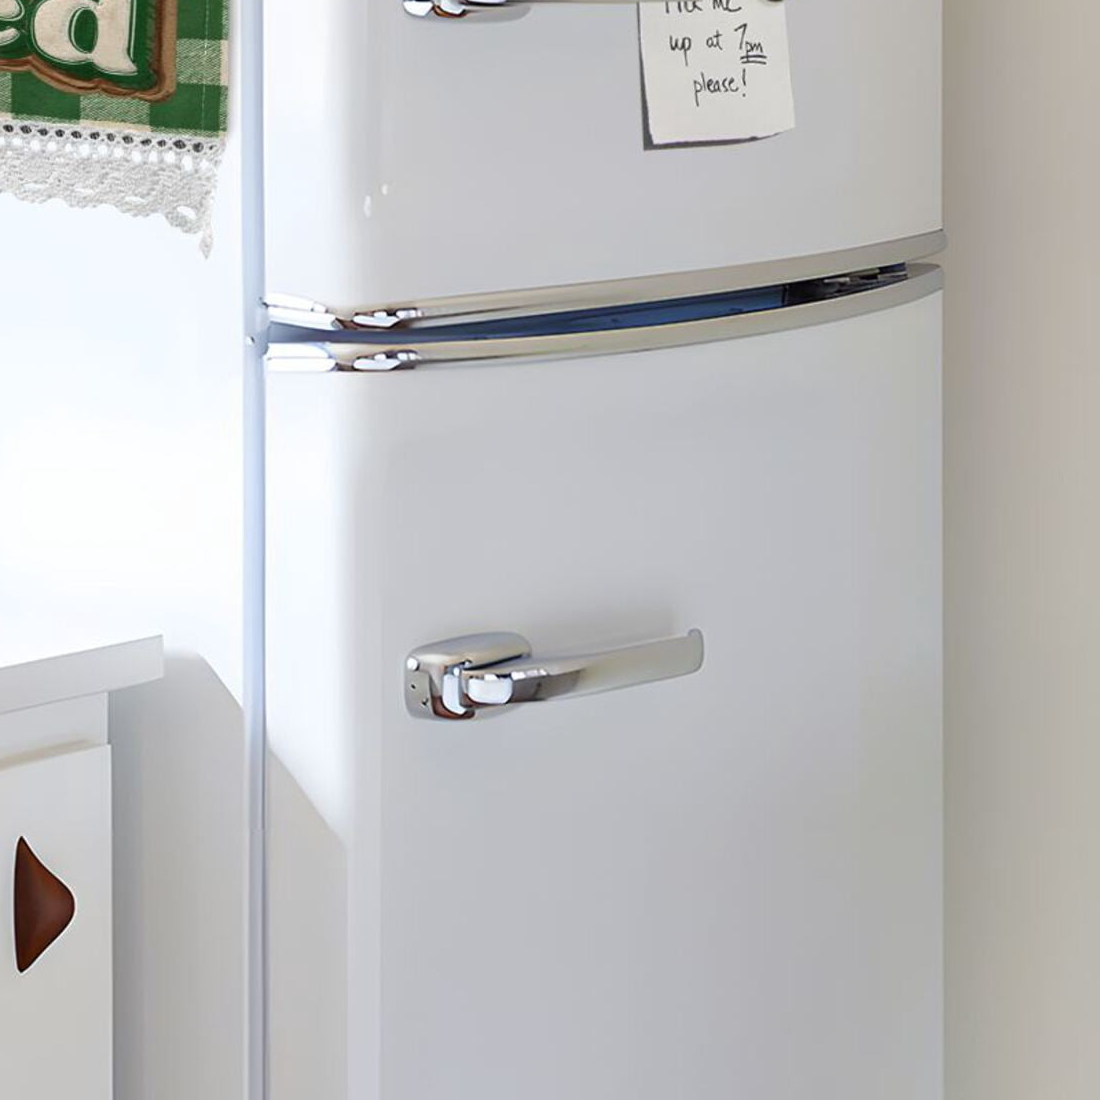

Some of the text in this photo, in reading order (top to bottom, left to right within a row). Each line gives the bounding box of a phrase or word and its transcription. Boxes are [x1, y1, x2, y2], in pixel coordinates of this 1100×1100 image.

[669, 34, 692, 67] up
[706, 30, 723, 51] at
[693, 68, 747, 107] please!
